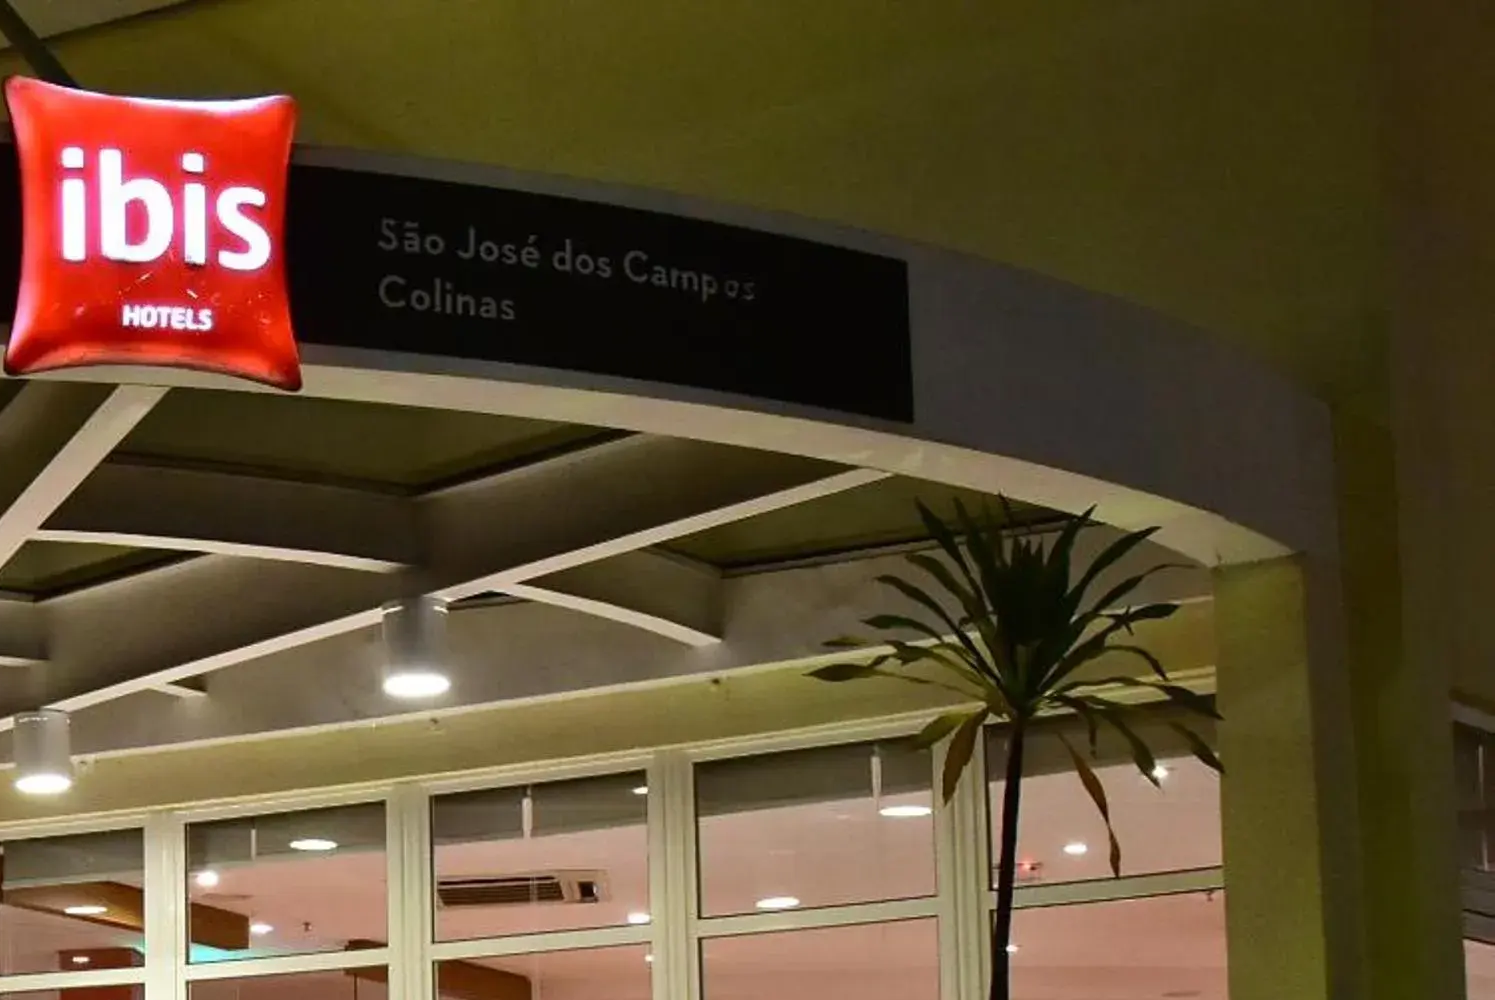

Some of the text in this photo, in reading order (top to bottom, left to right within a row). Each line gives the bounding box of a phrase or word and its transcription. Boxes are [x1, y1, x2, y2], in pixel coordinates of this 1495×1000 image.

[60, 146, 272, 271] ibis
[377, 217, 756, 303] São José dos Campos
[121, 304, 213, 330] HOTELS
[377, 274, 516, 321] Colinas
